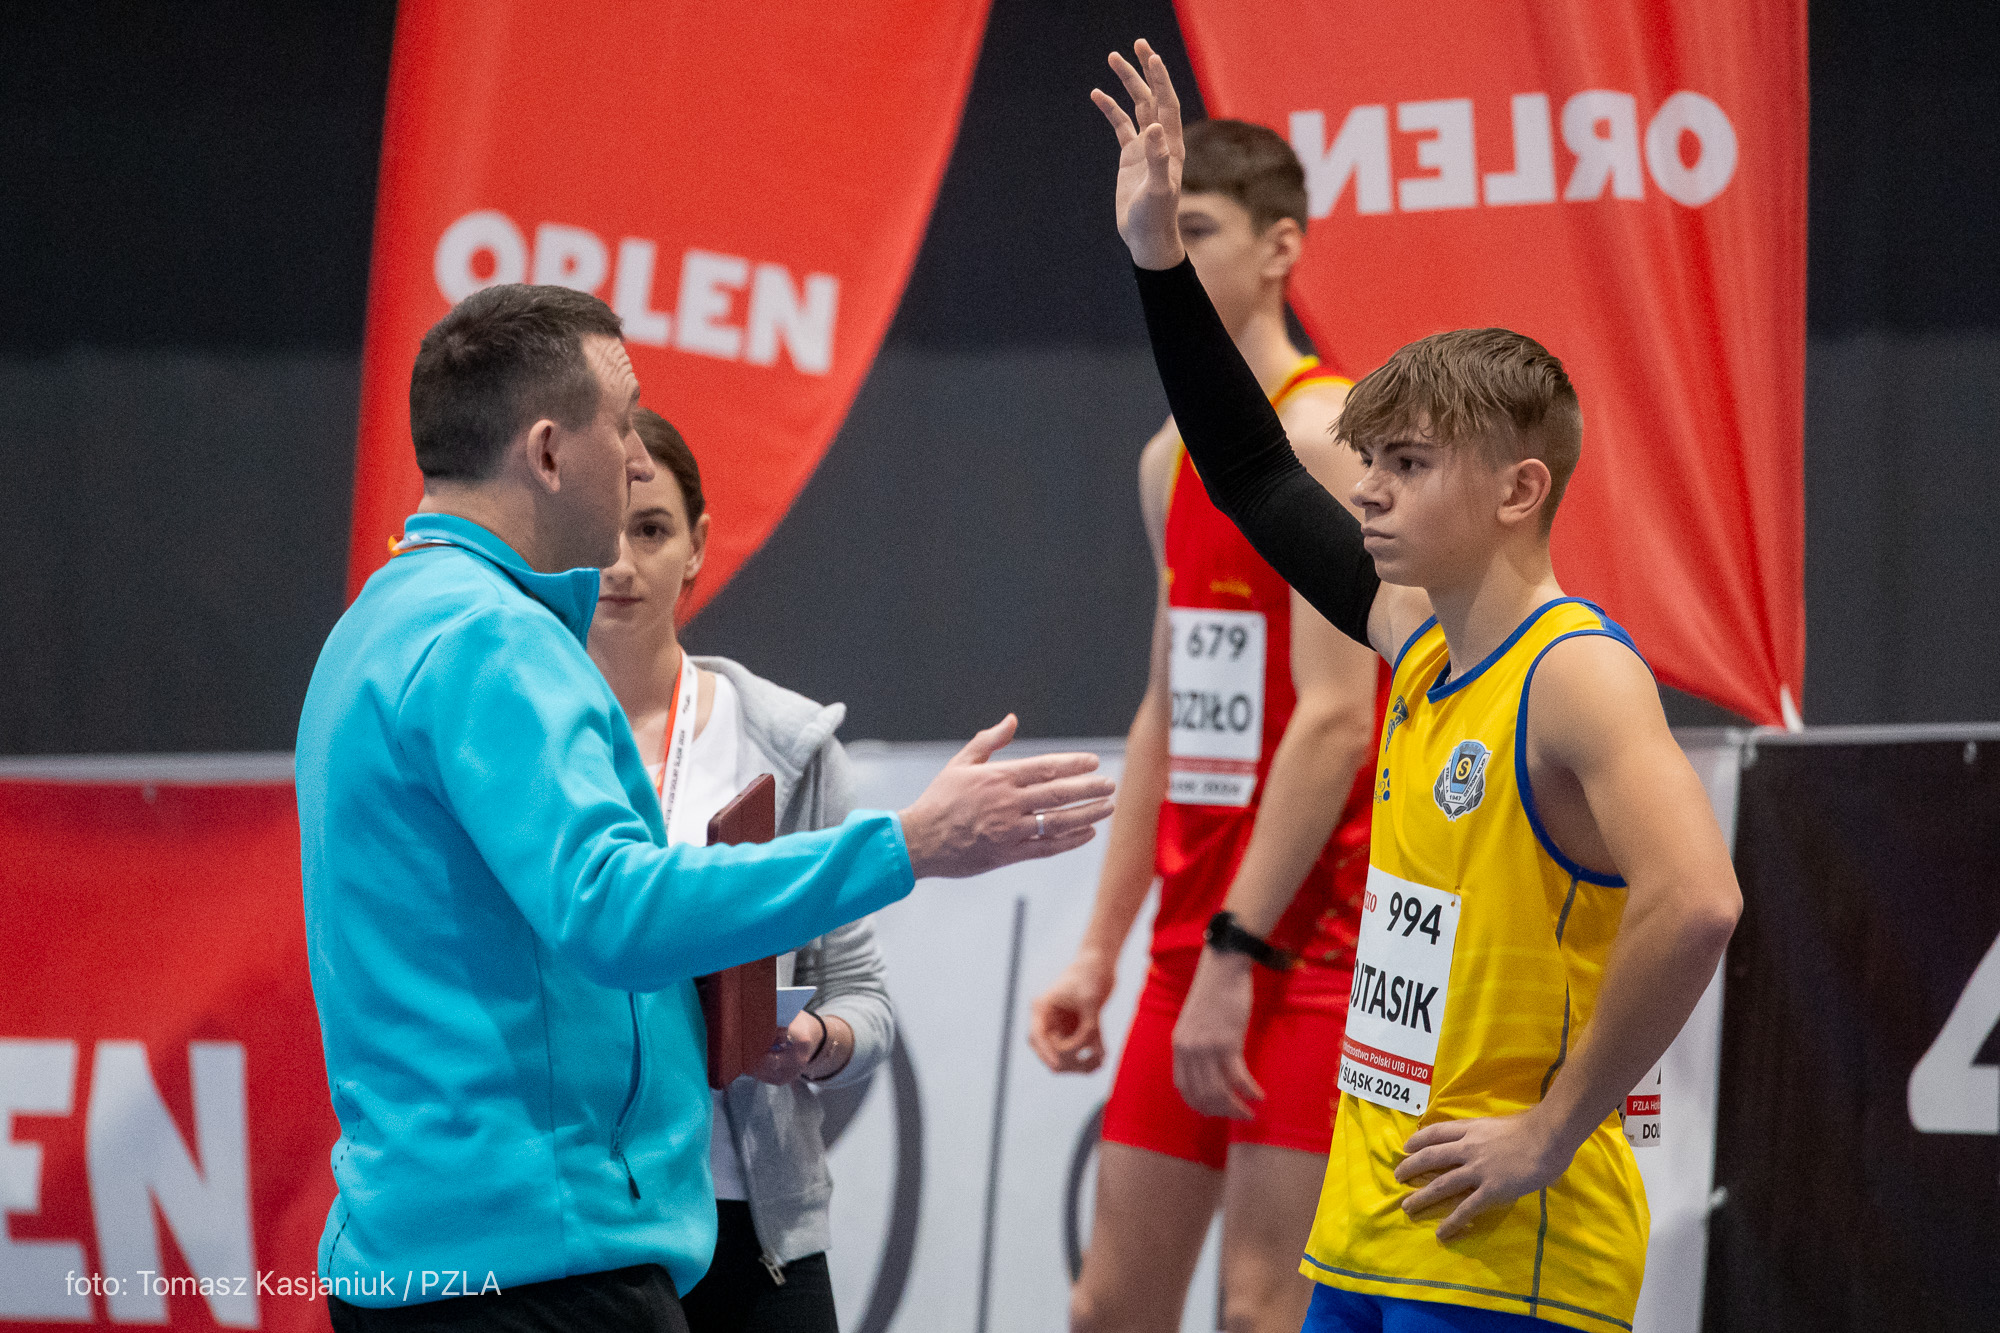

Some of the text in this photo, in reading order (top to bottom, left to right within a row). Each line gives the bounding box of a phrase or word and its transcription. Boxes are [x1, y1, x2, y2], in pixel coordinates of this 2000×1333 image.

[1186, 622, 1248, 661] 679
[1458, 760, 1469, 777] S
[1387, 891, 1443, 945] 994
[1369, 1053, 1391, 1068] Polski
[1391, 1060, 1406, 1073] U18
[1406, 1063, 1410, 1074] i
[1411, 1066, 1428, 1080] U20
[1343, 1061, 1374, 1092] ŚLĄSK
[1375, 1078, 1410, 1103] 2024
[1632, 1100, 1650, 1111] PZLA
[1643, 1122, 1660, 1139] DOL
